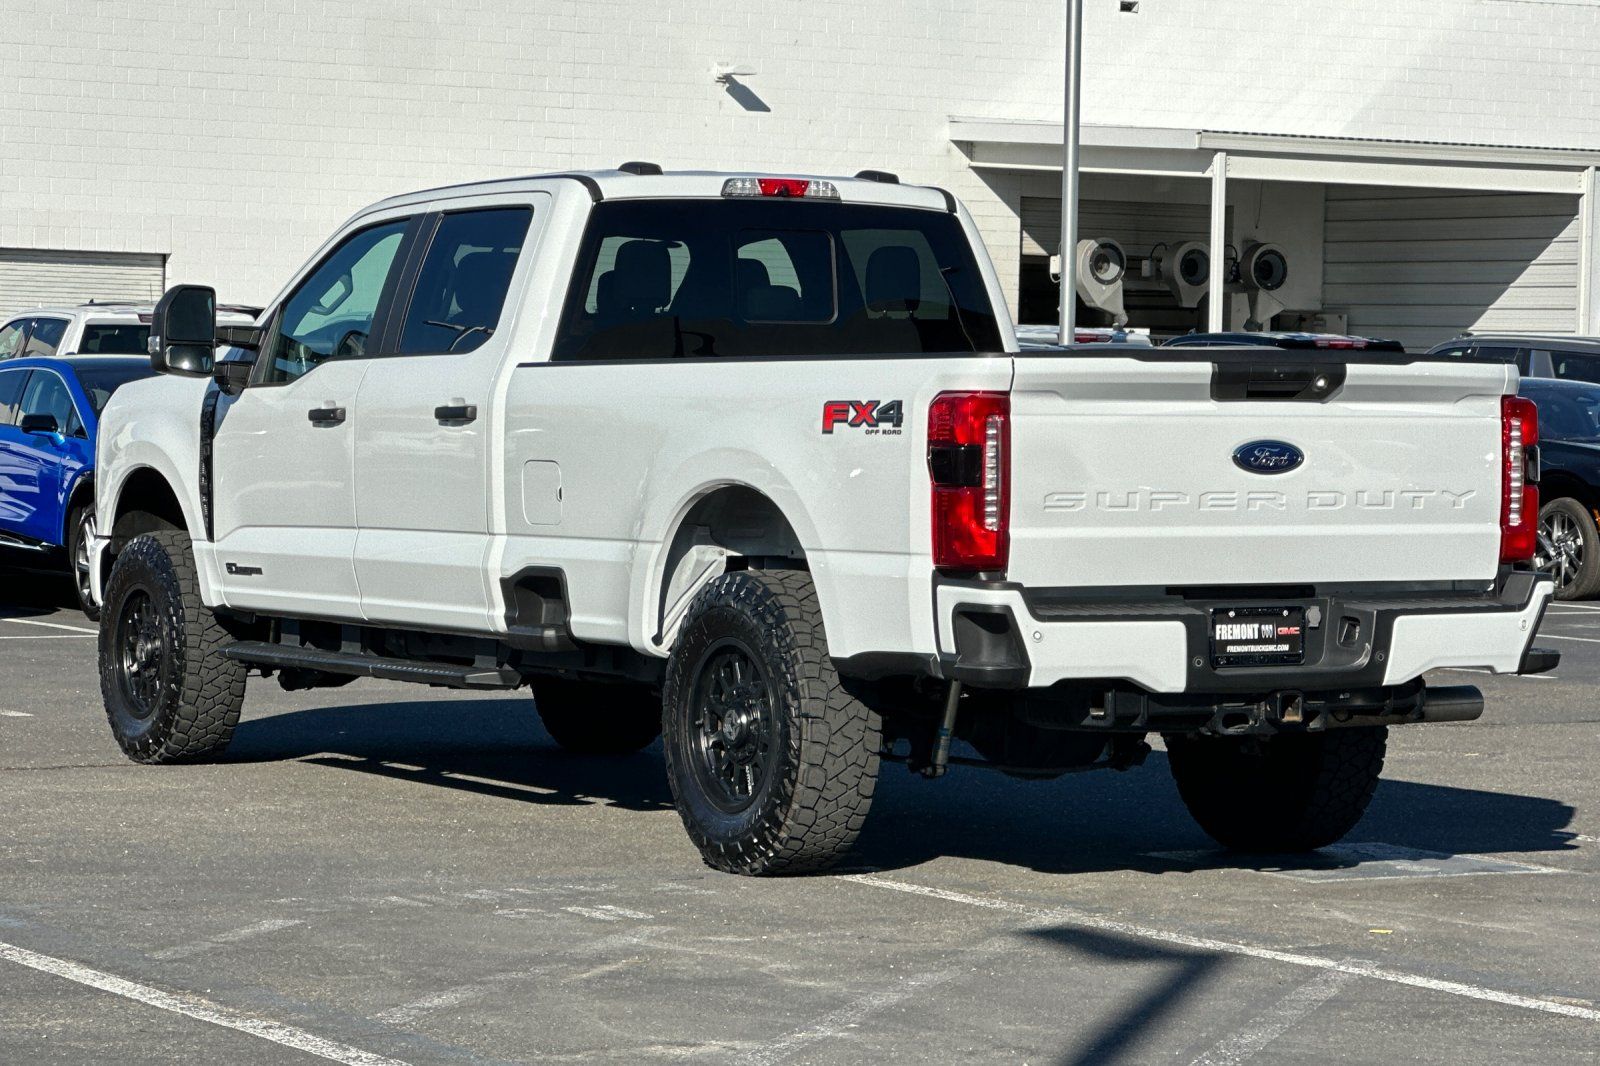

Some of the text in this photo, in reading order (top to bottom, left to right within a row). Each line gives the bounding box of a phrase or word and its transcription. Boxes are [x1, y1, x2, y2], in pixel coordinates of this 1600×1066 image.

[822, 400, 903, 434] FX4
[1250, 447, 1289, 467] Ford
[1043, 490, 1477, 512] SUPER DUTY
[1215, 623, 1300, 640] FREMONT GMC
